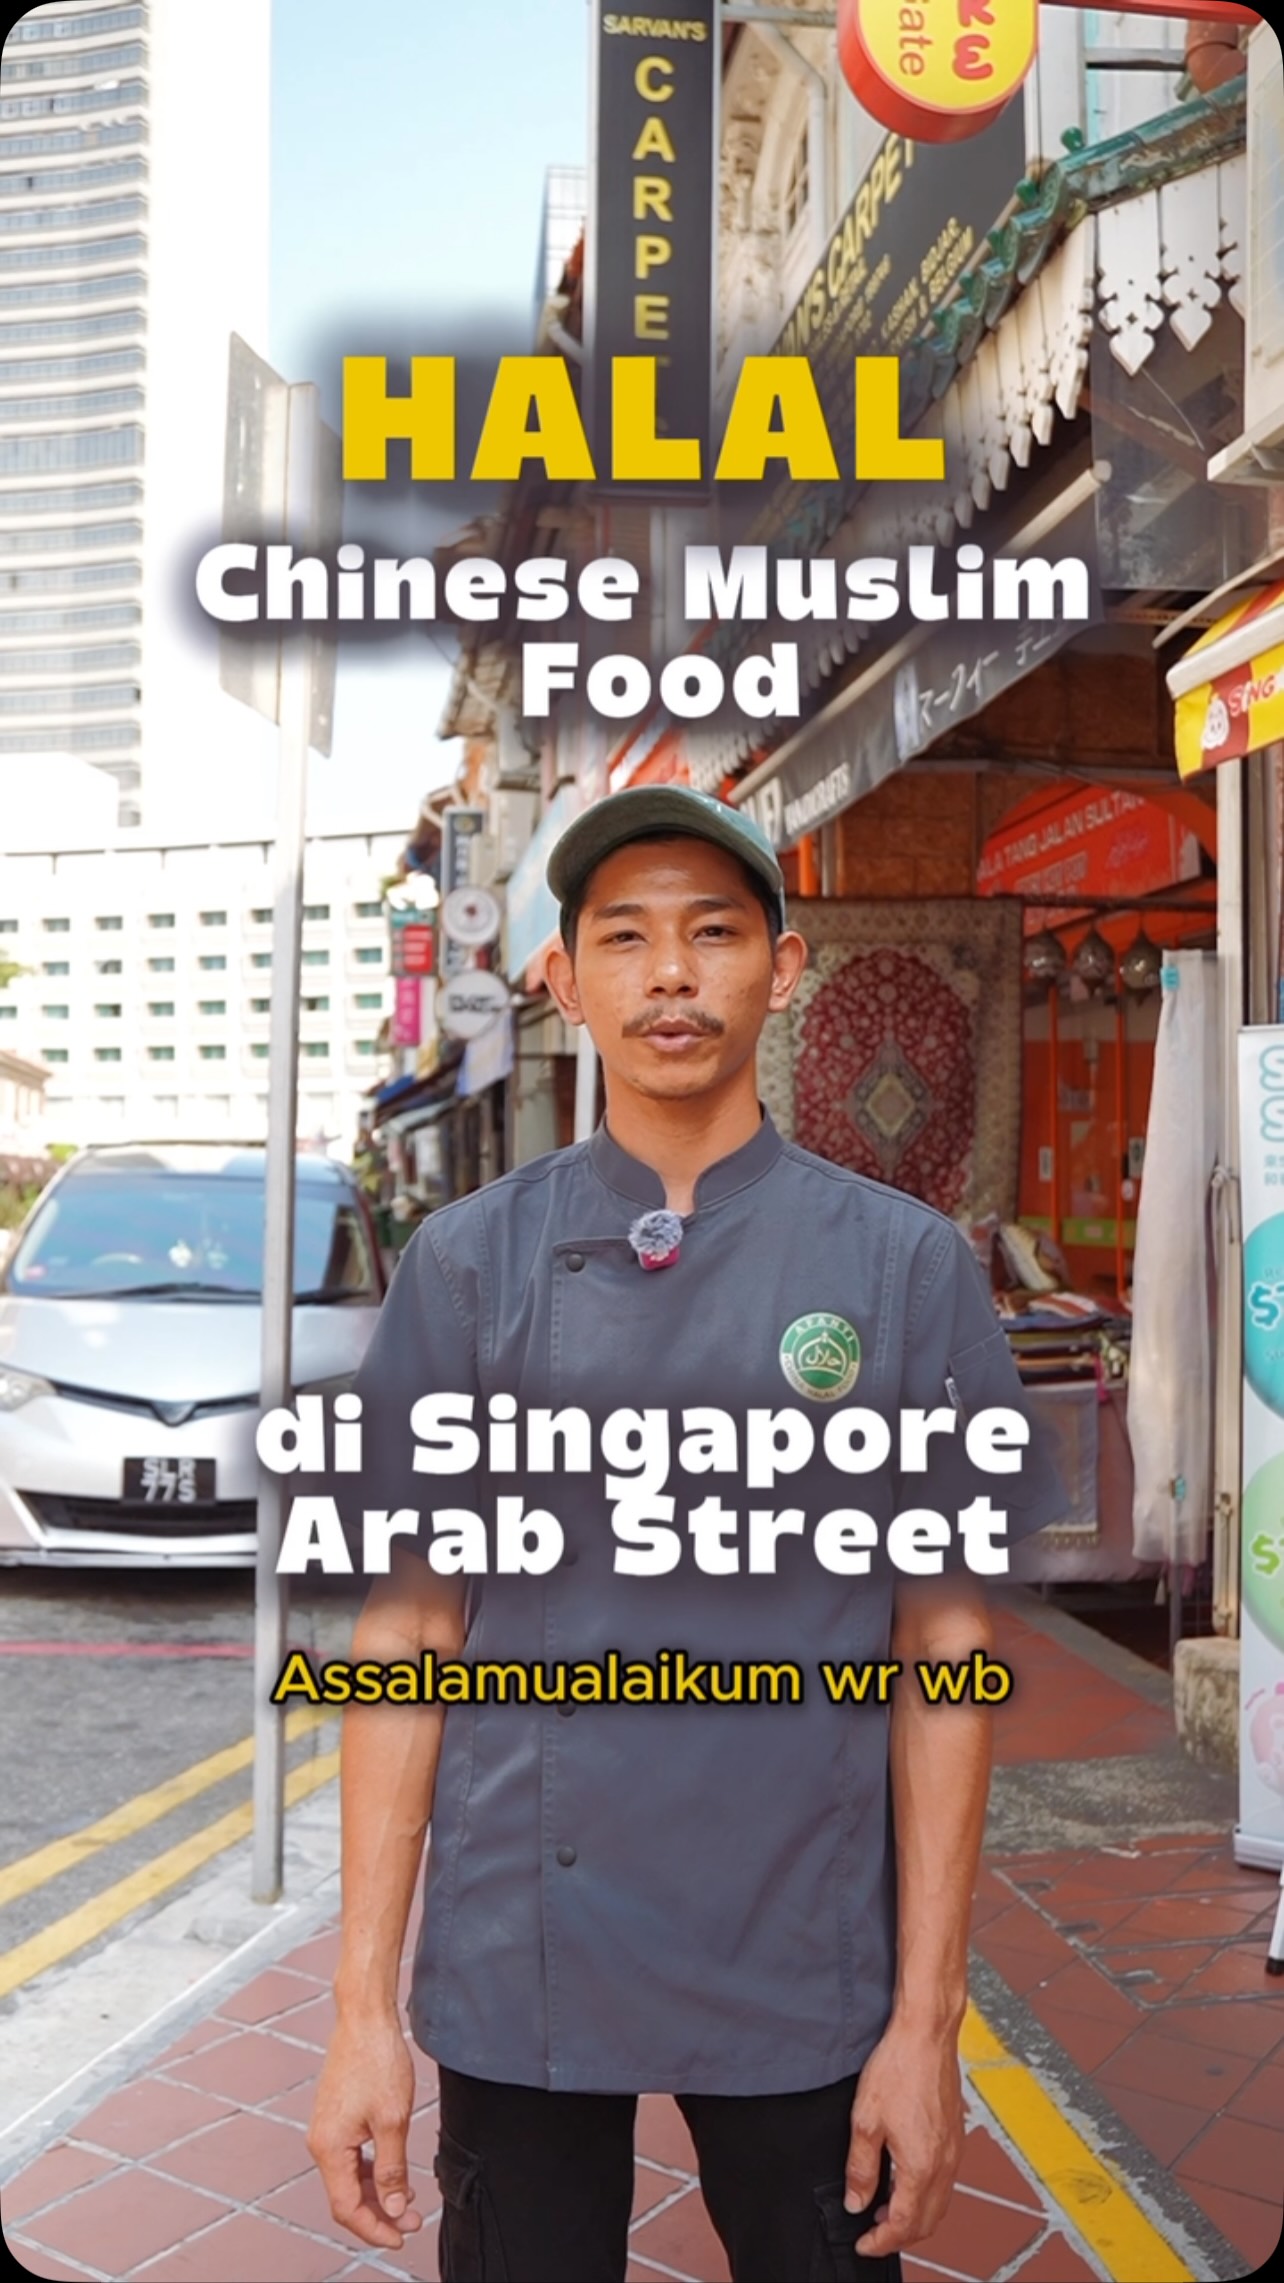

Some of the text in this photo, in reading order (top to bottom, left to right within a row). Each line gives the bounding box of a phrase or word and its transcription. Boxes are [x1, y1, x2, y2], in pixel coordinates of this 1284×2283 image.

[602, 14, 708, 42] SARVAN'S
[898, 0, 934, 77] ate
[633, 56, 676, 366] CARPE
[1039, 810, 1085, 853] JALAN
